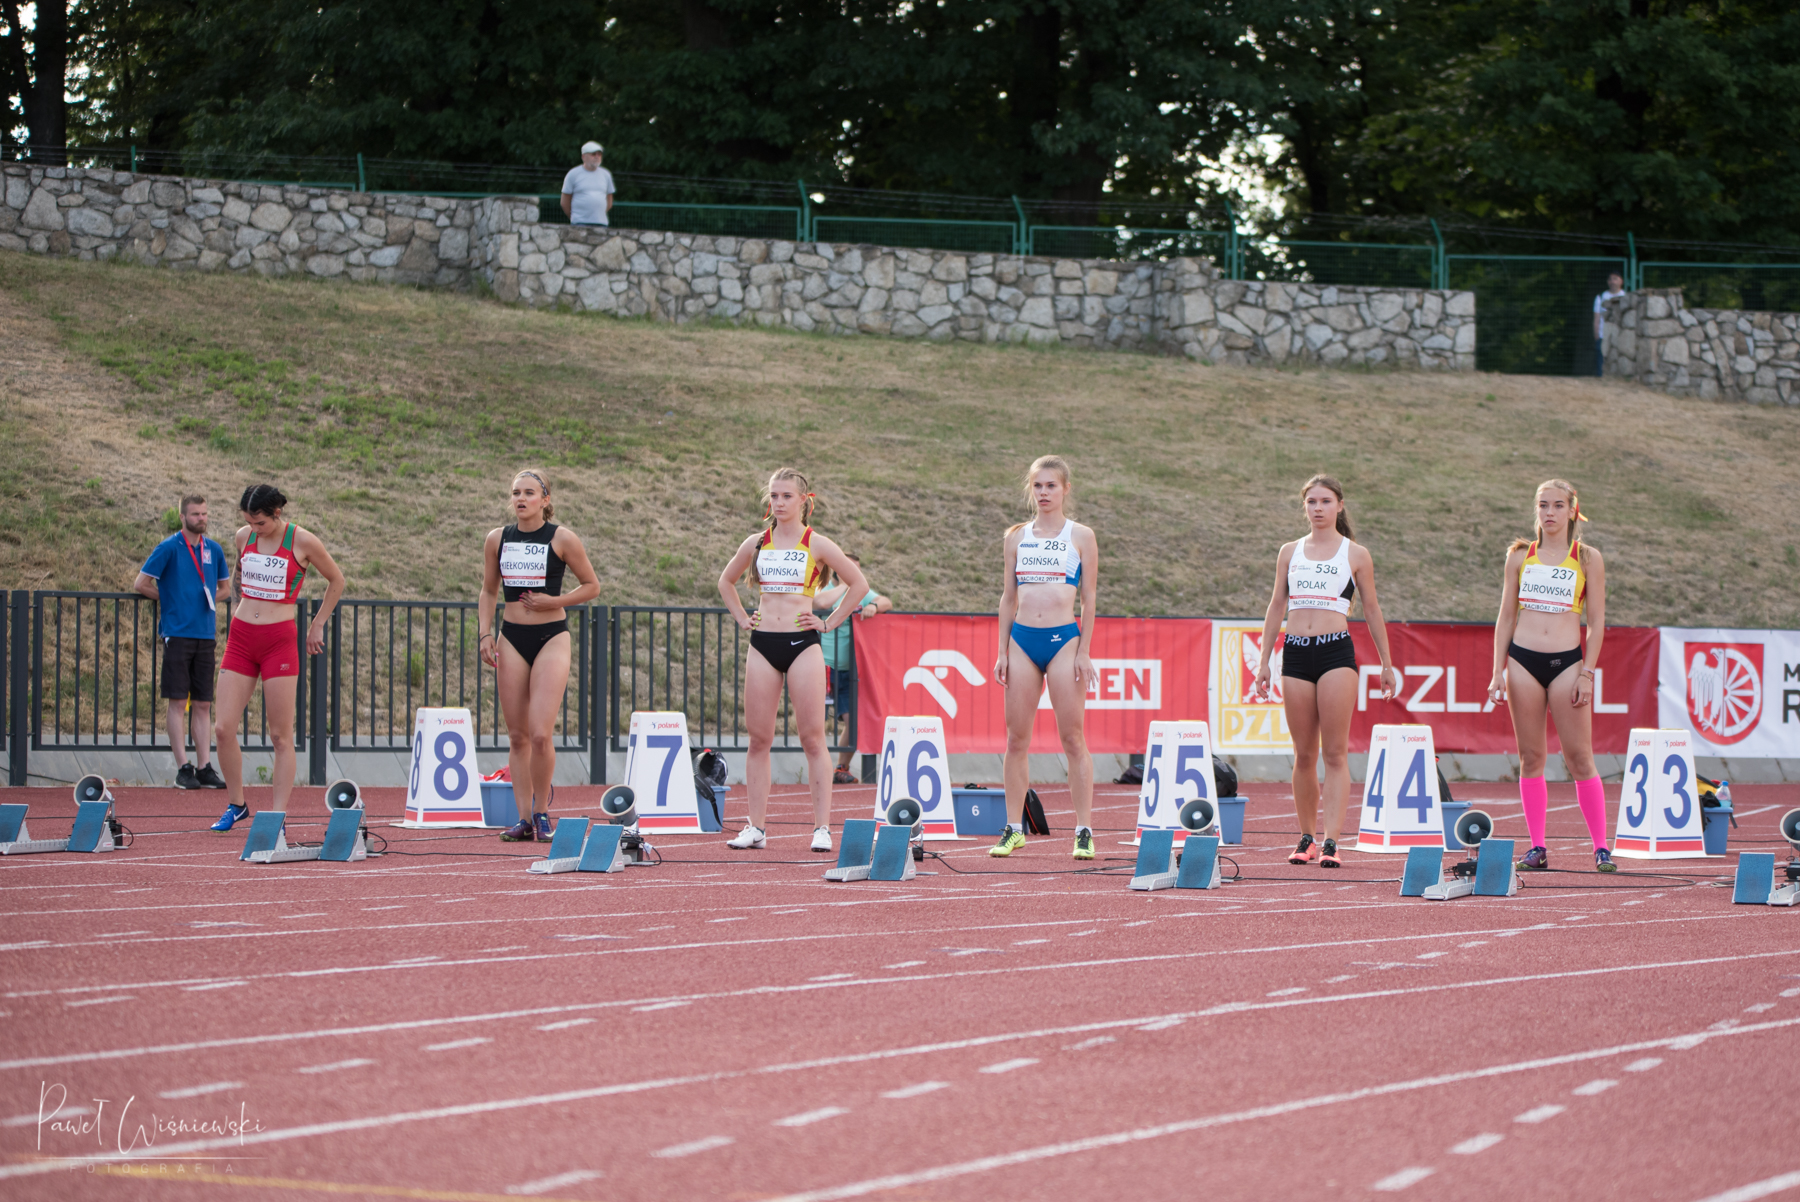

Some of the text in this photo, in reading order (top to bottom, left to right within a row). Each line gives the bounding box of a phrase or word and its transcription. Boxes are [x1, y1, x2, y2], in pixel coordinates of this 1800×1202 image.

[524, 545, 545, 555] 504
[1044, 540, 1067, 551] 283
[783, 551, 805, 562] 232
[1022, 555, 1060, 566] OSIŃSKA
[264, 557, 285, 569] 399
[1315, 563, 1338, 575] 538
[242, 571, 284, 584] MIKIEWICZ
[761, 566, 799, 577] LIPIŃSKA
[1551, 568, 1574, 580] 237
[1297, 580, 1327, 590] POLAK
[1522, 581, 1572, 598] ŻUROWSKA
[1286, 634, 1310, 646] PRO
[1407, 735, 1427, 743] polanik
[1669, 740, 1687, 748] polanik
[411, 730, 469, 801] 8 8
[646, 735, 683, 806] 7
[880, 740, 941, 813] 6 6
[1145, 744, 1208, 818] 5 5
[1366, 748, 1433, 823] 4 4
[1626, 753, 1692, 829] 3 3
[971, 805, 980, 816] 6
